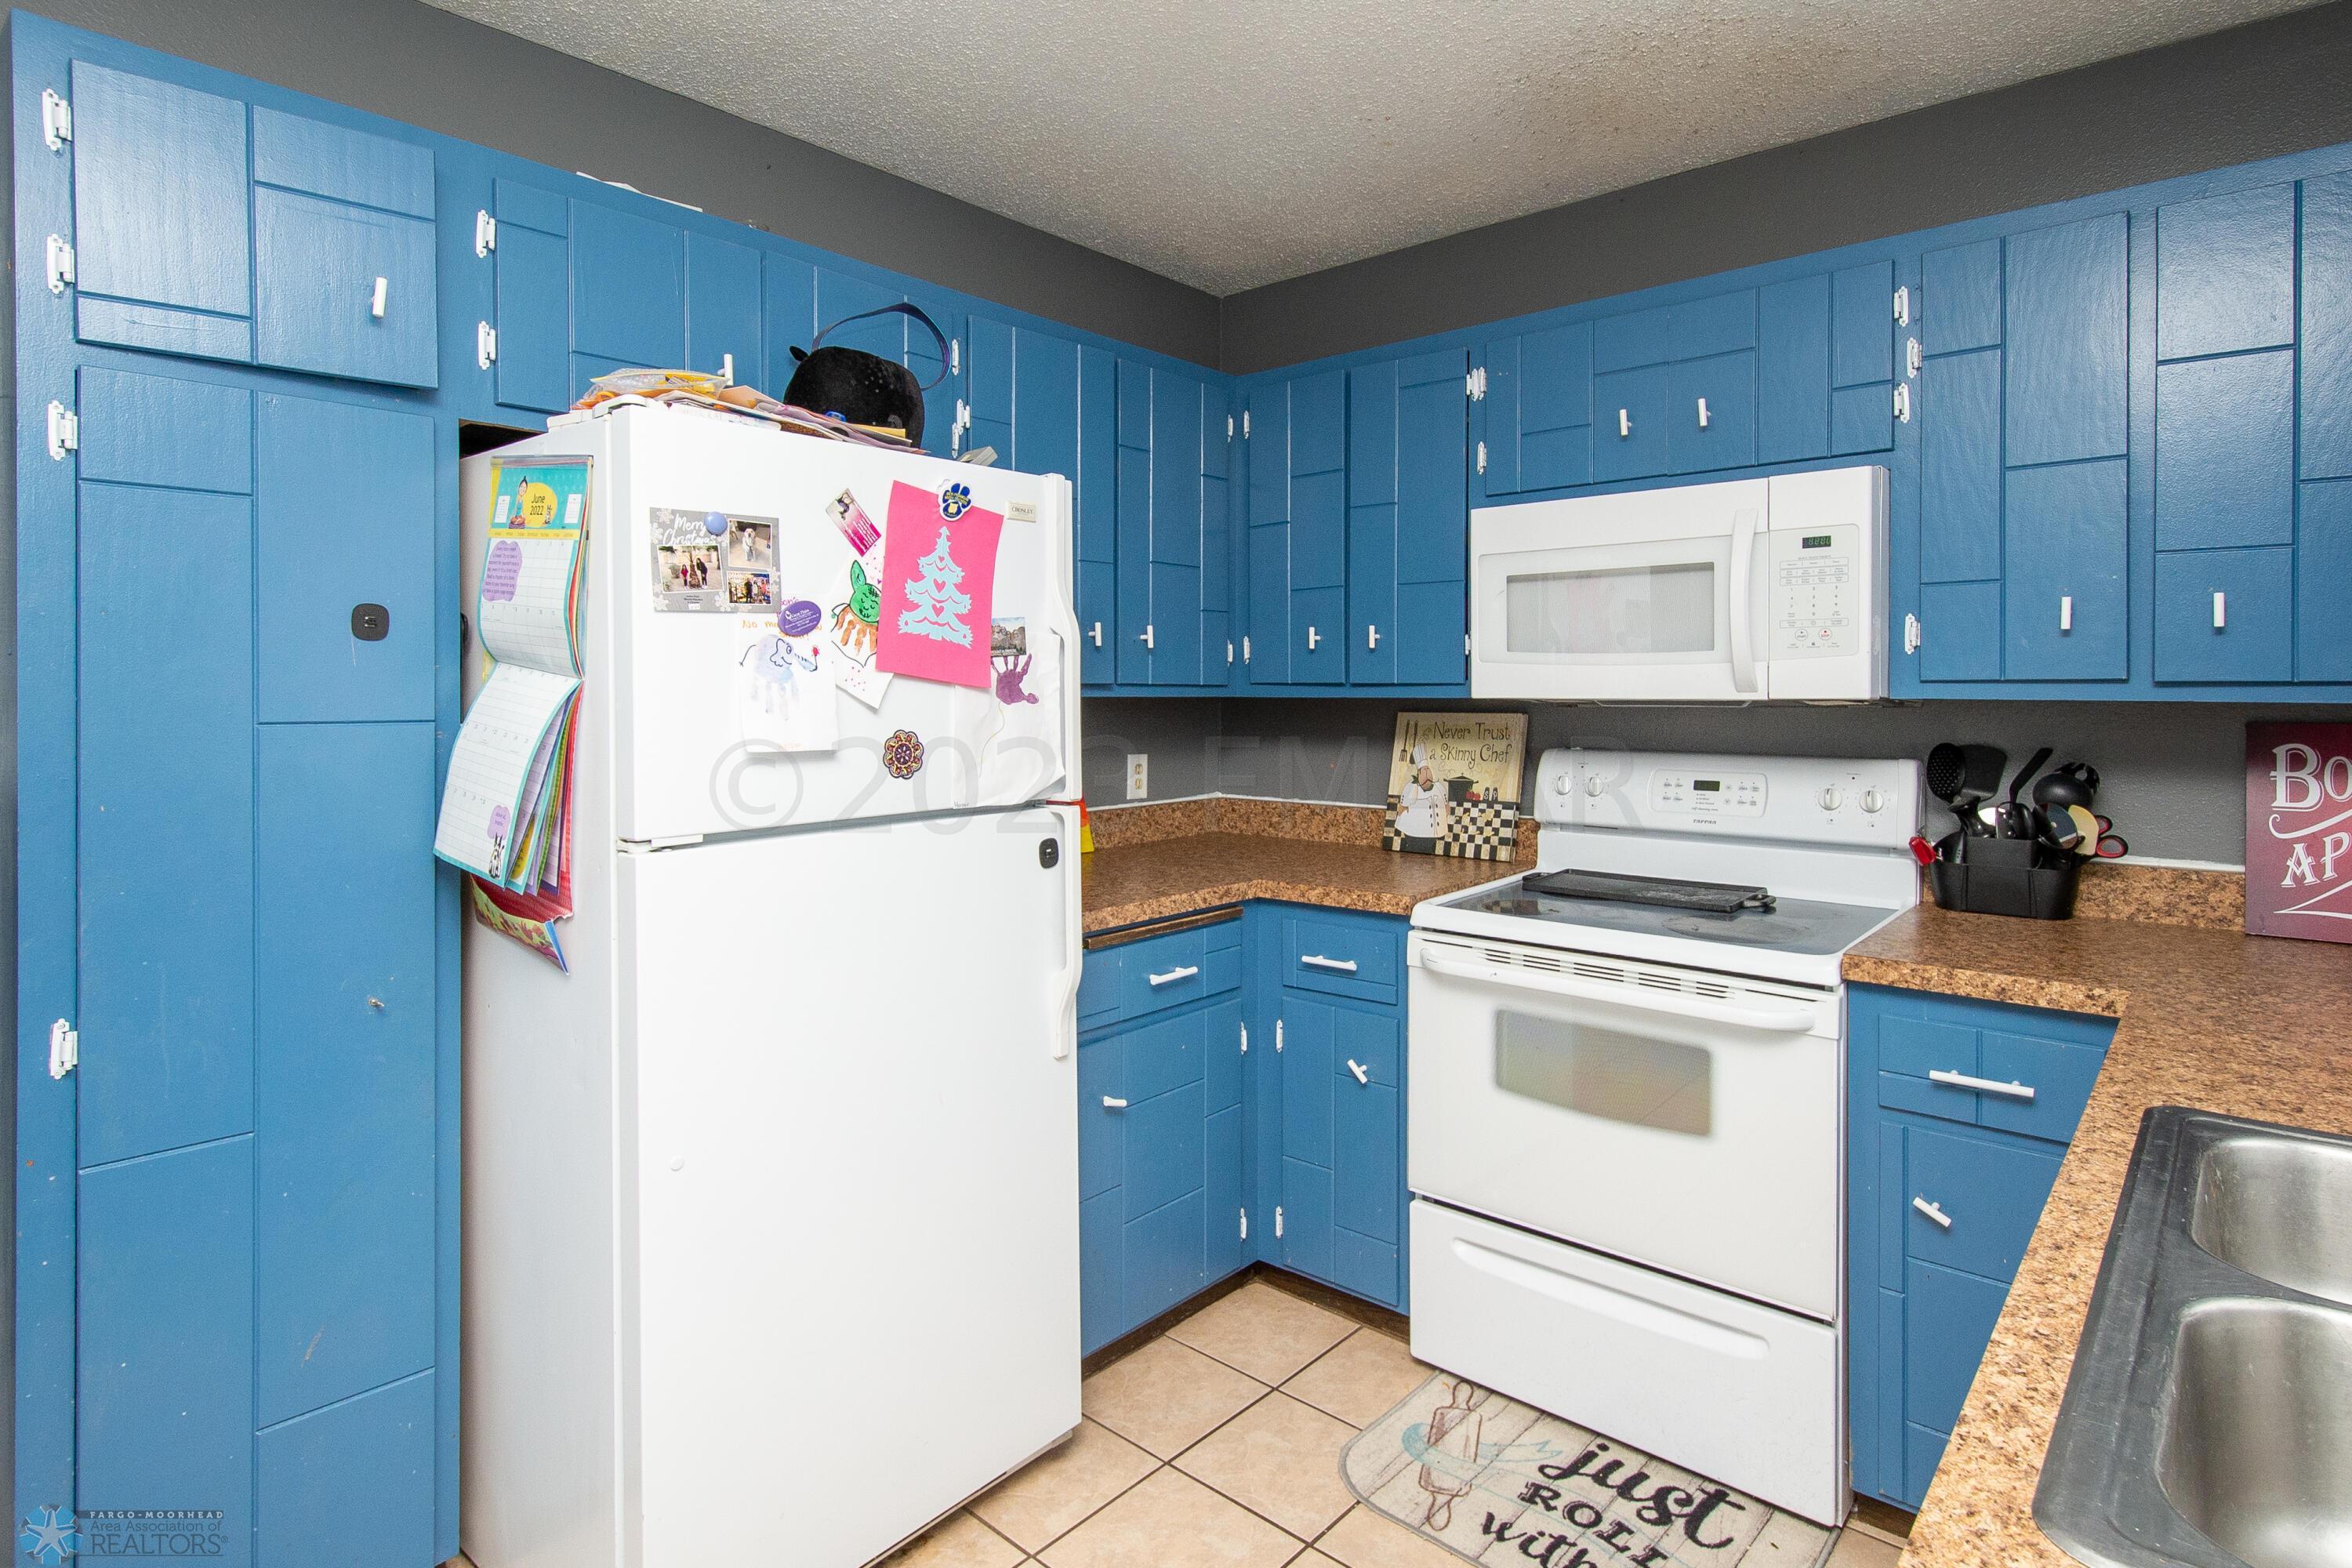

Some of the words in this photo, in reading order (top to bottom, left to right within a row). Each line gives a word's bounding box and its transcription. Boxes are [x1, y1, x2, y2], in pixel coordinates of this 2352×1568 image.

[531, 493, 546, 503] June
[529, 505, 544, 516] 2022
[674, 513, 706, 536] Merry
[662, 528, 717, 546] Christmas
[742, 619, 758, 629] No
[1433, 721, 1471, 740] Never
[1475, 722, 1511, 741] Trust
[1429, 749, 1436, 760] a
[1440, 742, 1476, 769] Skinny
[1479, 743, 1512, 764] Chef
[1537, 1442, 1746, 1549] just
